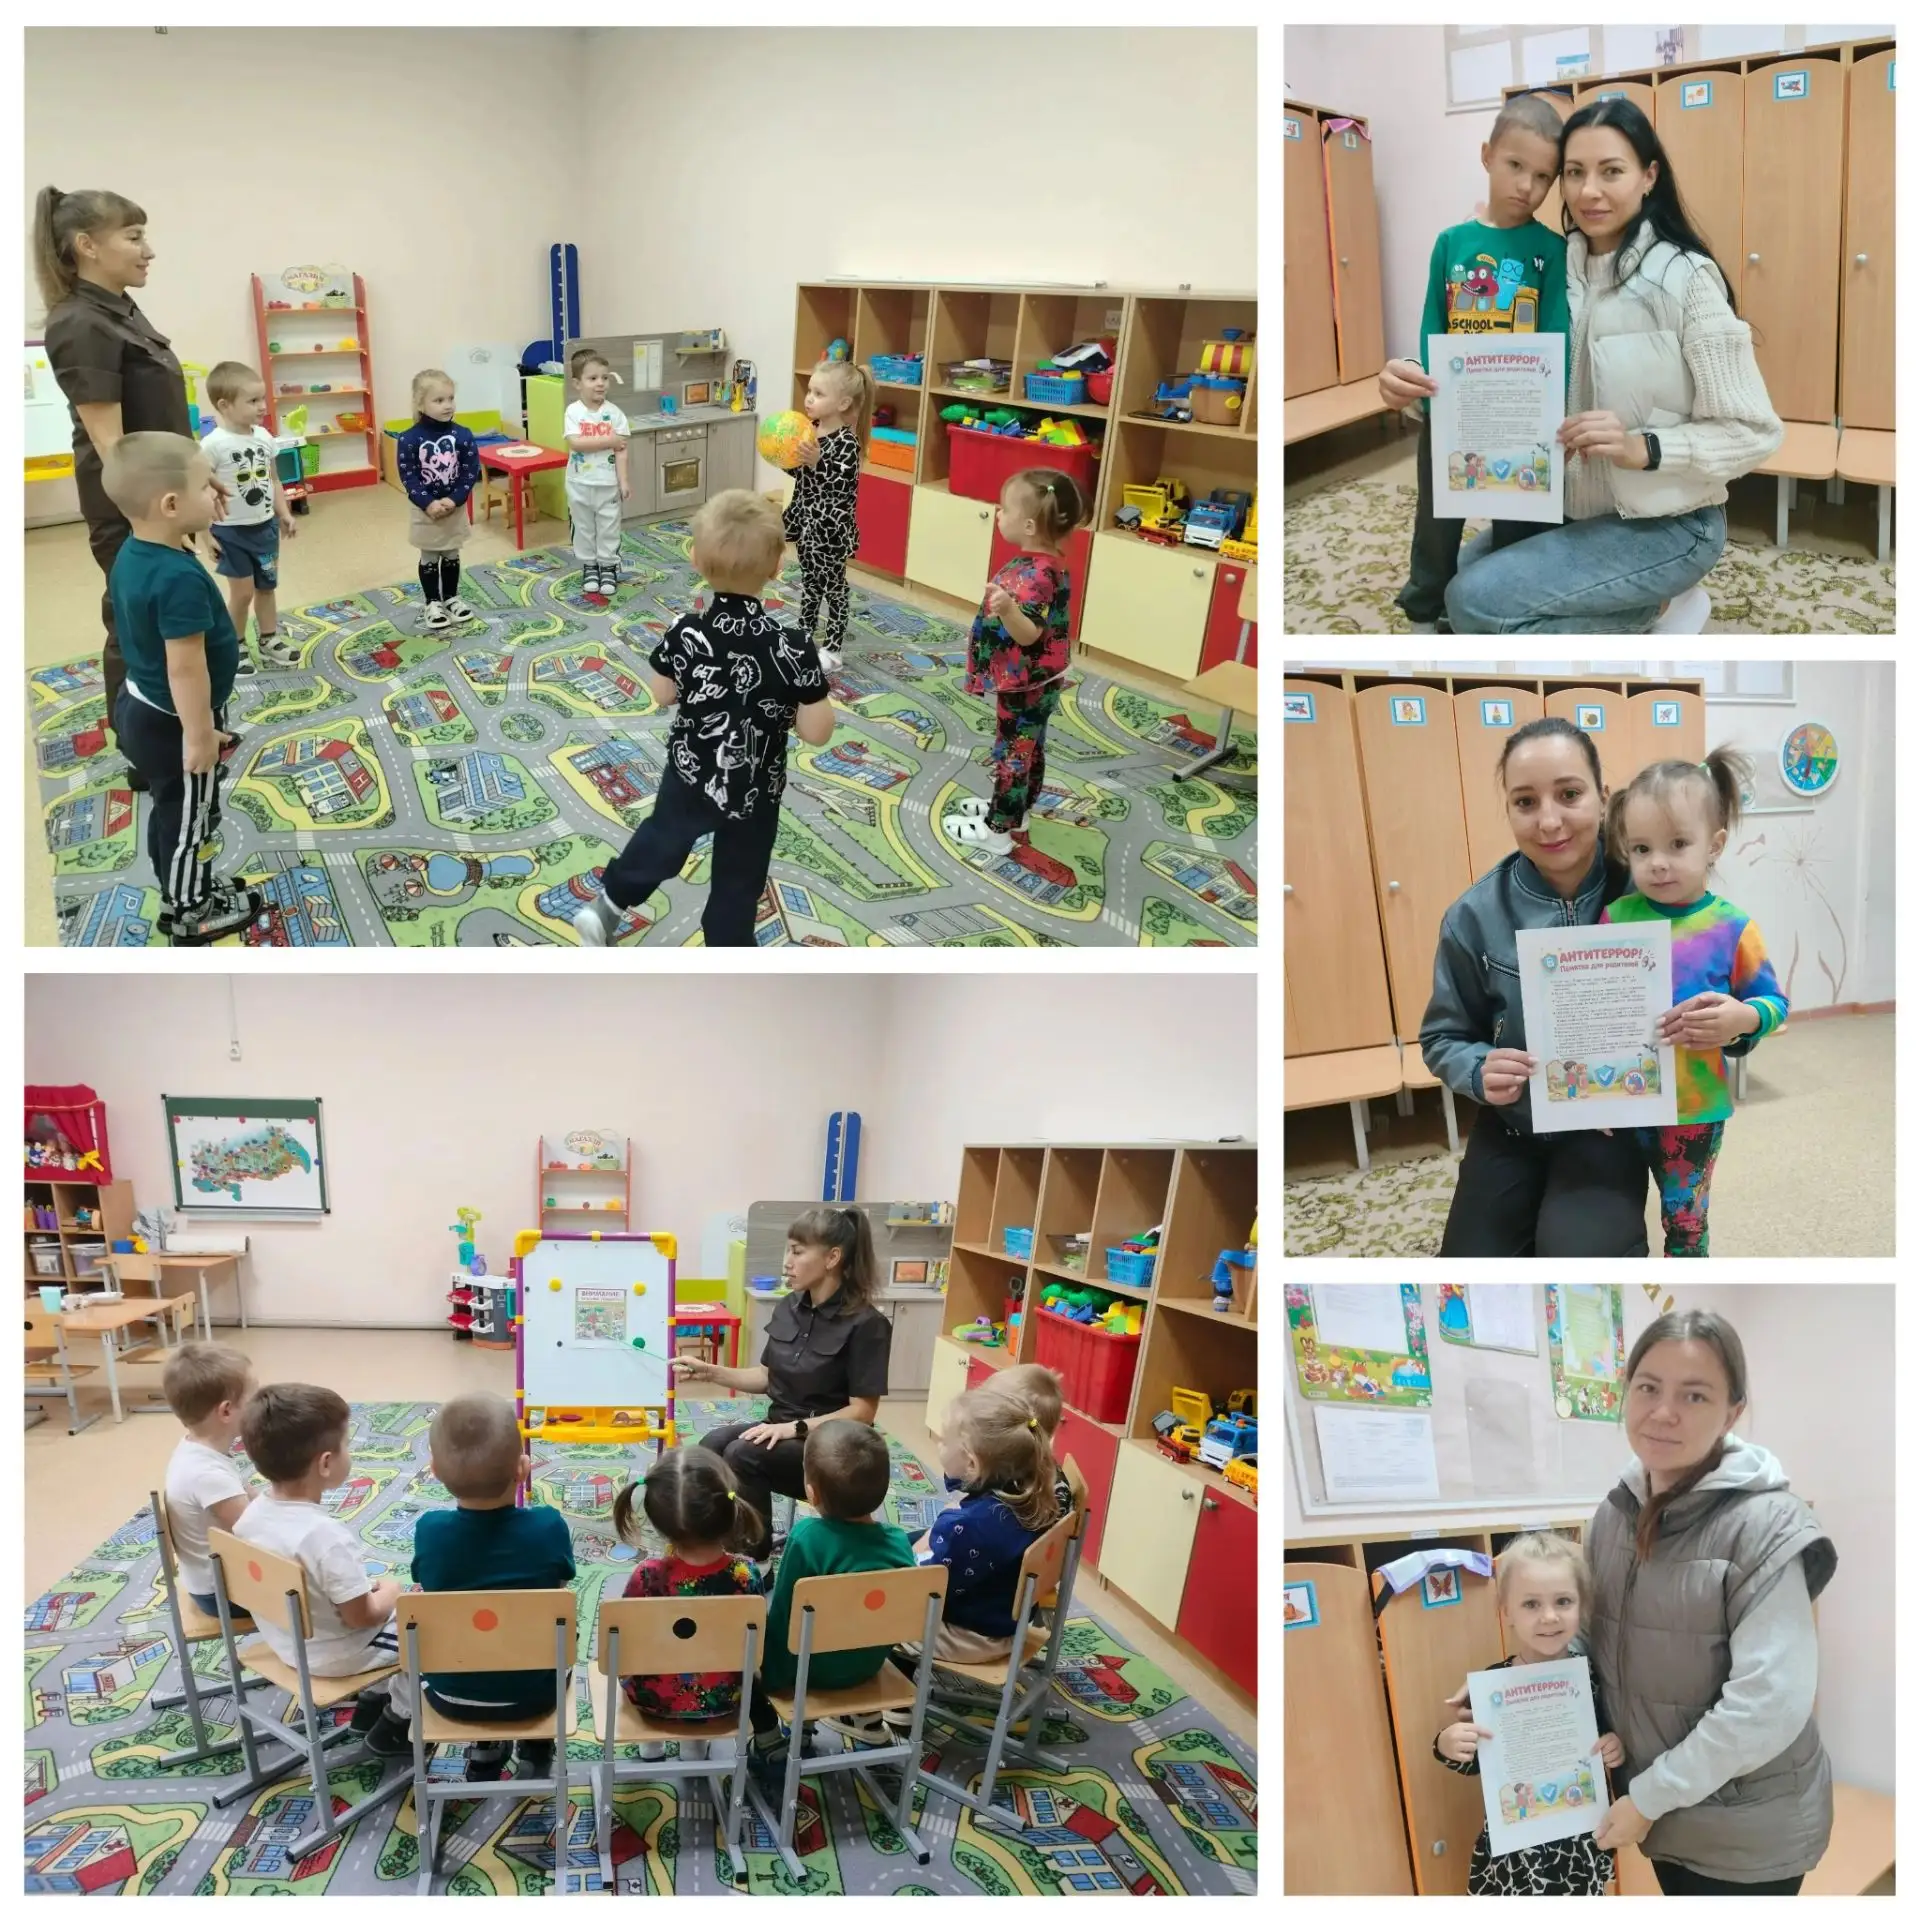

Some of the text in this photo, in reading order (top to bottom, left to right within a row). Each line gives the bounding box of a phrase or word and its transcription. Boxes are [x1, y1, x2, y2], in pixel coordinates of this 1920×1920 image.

[1452, 318, 1493, 330] SCHOOL
[692, 664, 721, 681] GET
[699, 680, 728, 699] YOU
[687, 690, 707, 705] UP
[1559, 948, 1643, 963] АНТИТЕРРОР!
[1560, 963, 1589, 973] Памятка
[1591, 962, 1603, 970] для
[1504, 1680, 1569, 1699] АНТИТЕРРОР!
